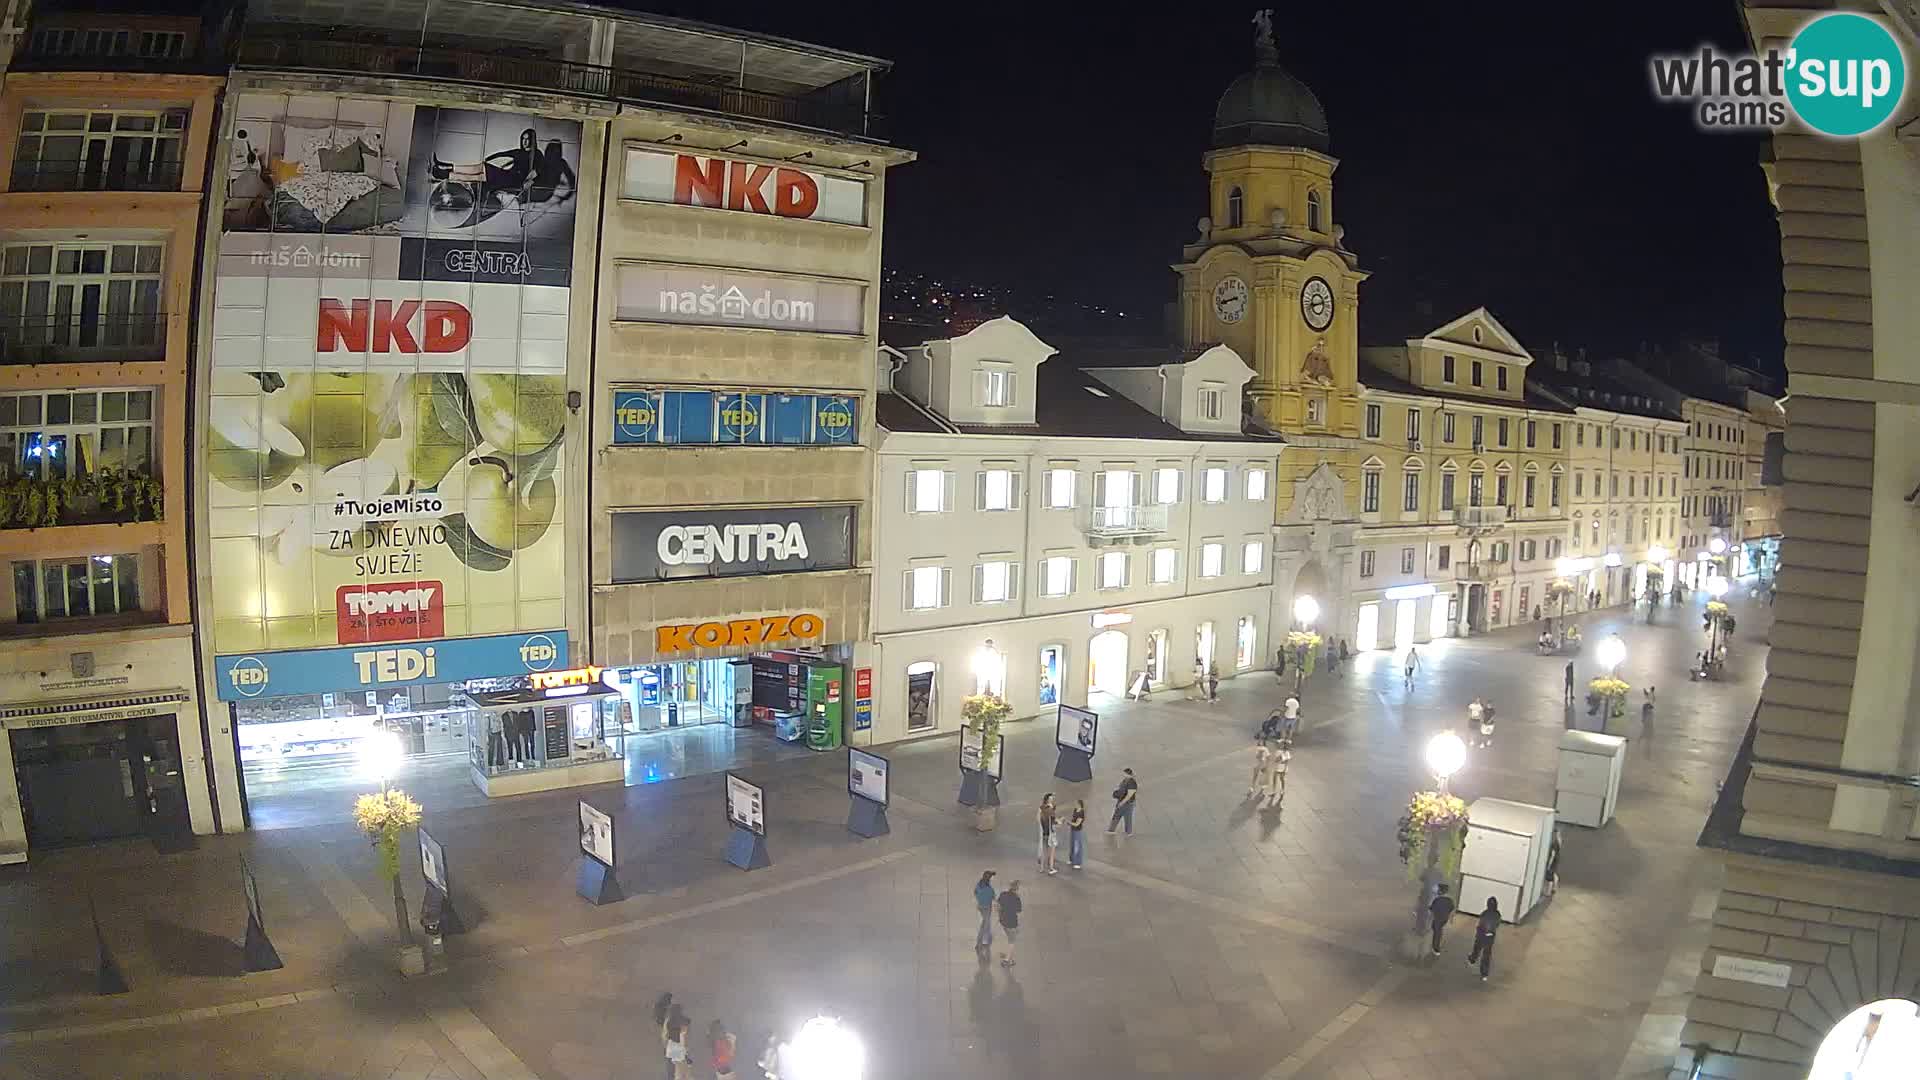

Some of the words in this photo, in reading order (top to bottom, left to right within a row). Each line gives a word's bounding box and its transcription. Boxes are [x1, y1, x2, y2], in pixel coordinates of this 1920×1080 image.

[674, 154, 819, 219] NKD
[250, 245, 290, 267] naš
[315, 246, 361, 268] dom
[445, 250, 531, 275] CENTRA
[660, 285, 716, 315] naš
[752, 290, 815, 322] dom
[316, 298, 473, 353] NKD
[616, 409, 656, 425] TEDi
[722, 410, 758, 426] TEDi
[819, 412, 851, 427] TEDi
[334, 498, 442, 516] #TvojeMisto
[330, 530, 353, 549] ZA
[365, 525, 447, 549] DNEVNO
[657, 522, 808, 565] CENTRA
[355, 549, 423, 576] SVJEŽE
[344, 588, 436, 616] TOMMY
[656, 613, 824, 653] KORZO
[354, 647, 436, 684] TEDi
[520, 645, 556, 663] TEDi
[229, 667, 268, 686] TEDi
[530, 665, 603, 690] TOMMY
